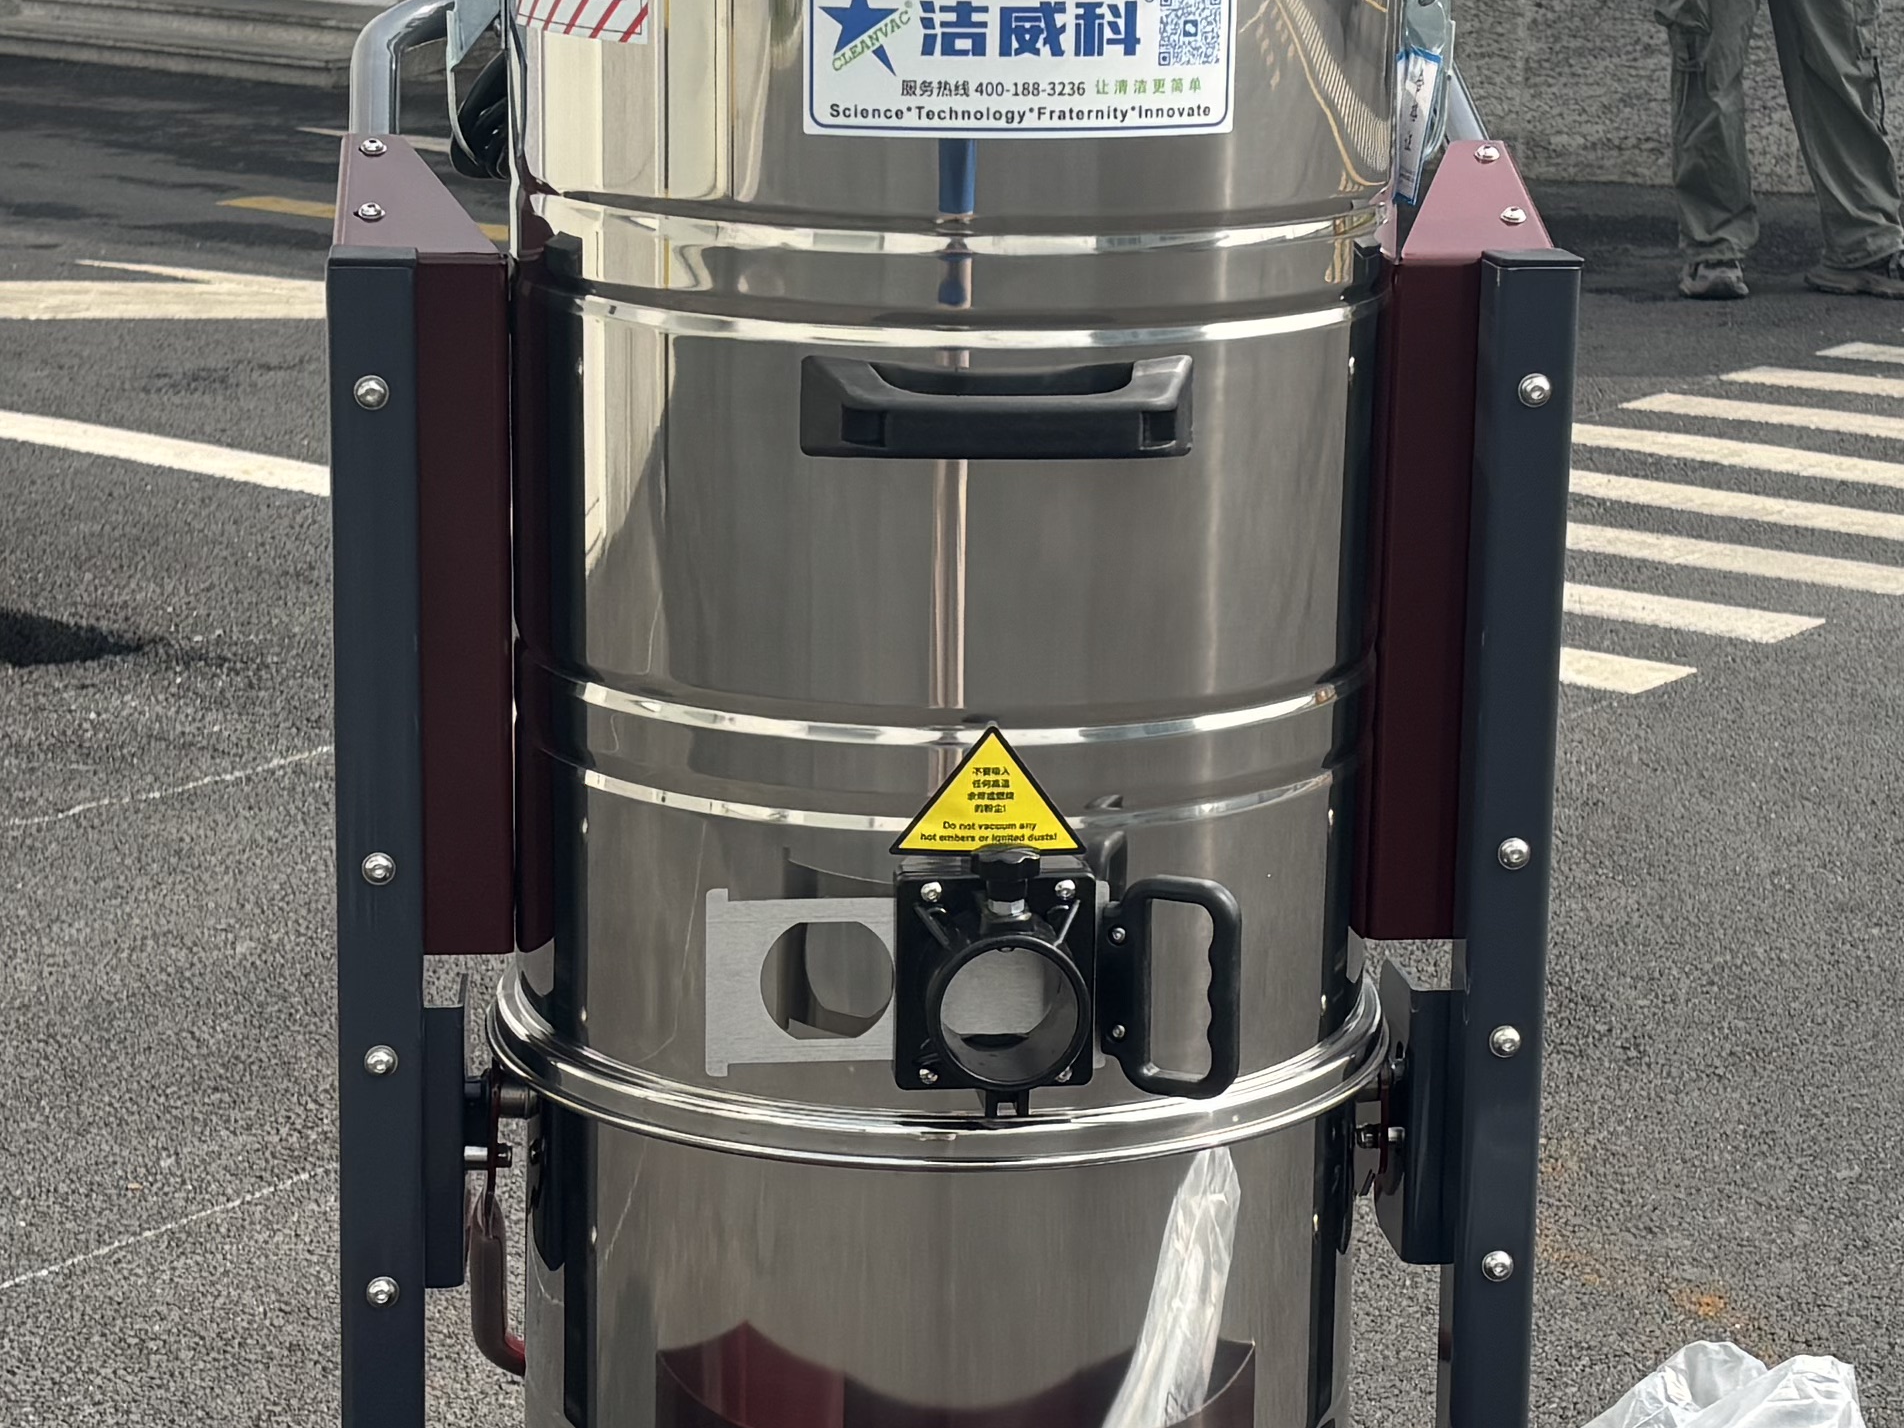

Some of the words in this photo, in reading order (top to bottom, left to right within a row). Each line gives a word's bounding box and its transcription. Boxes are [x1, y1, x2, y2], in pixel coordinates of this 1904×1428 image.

[919, 0, 1141, 58] 洁威科
[831, 8, 912, 72] CLEANVAC
[900, 79, 971, 98] 服务热线
[974, 80, 1086, 97] 400-188-3236
[942, 821, 957, 830] Do
[959, 822, 976, 831] not
[920, 833, 937, 841] hot
[939, 833, 976, 842] embers
[978, 834, 989, 842] or
